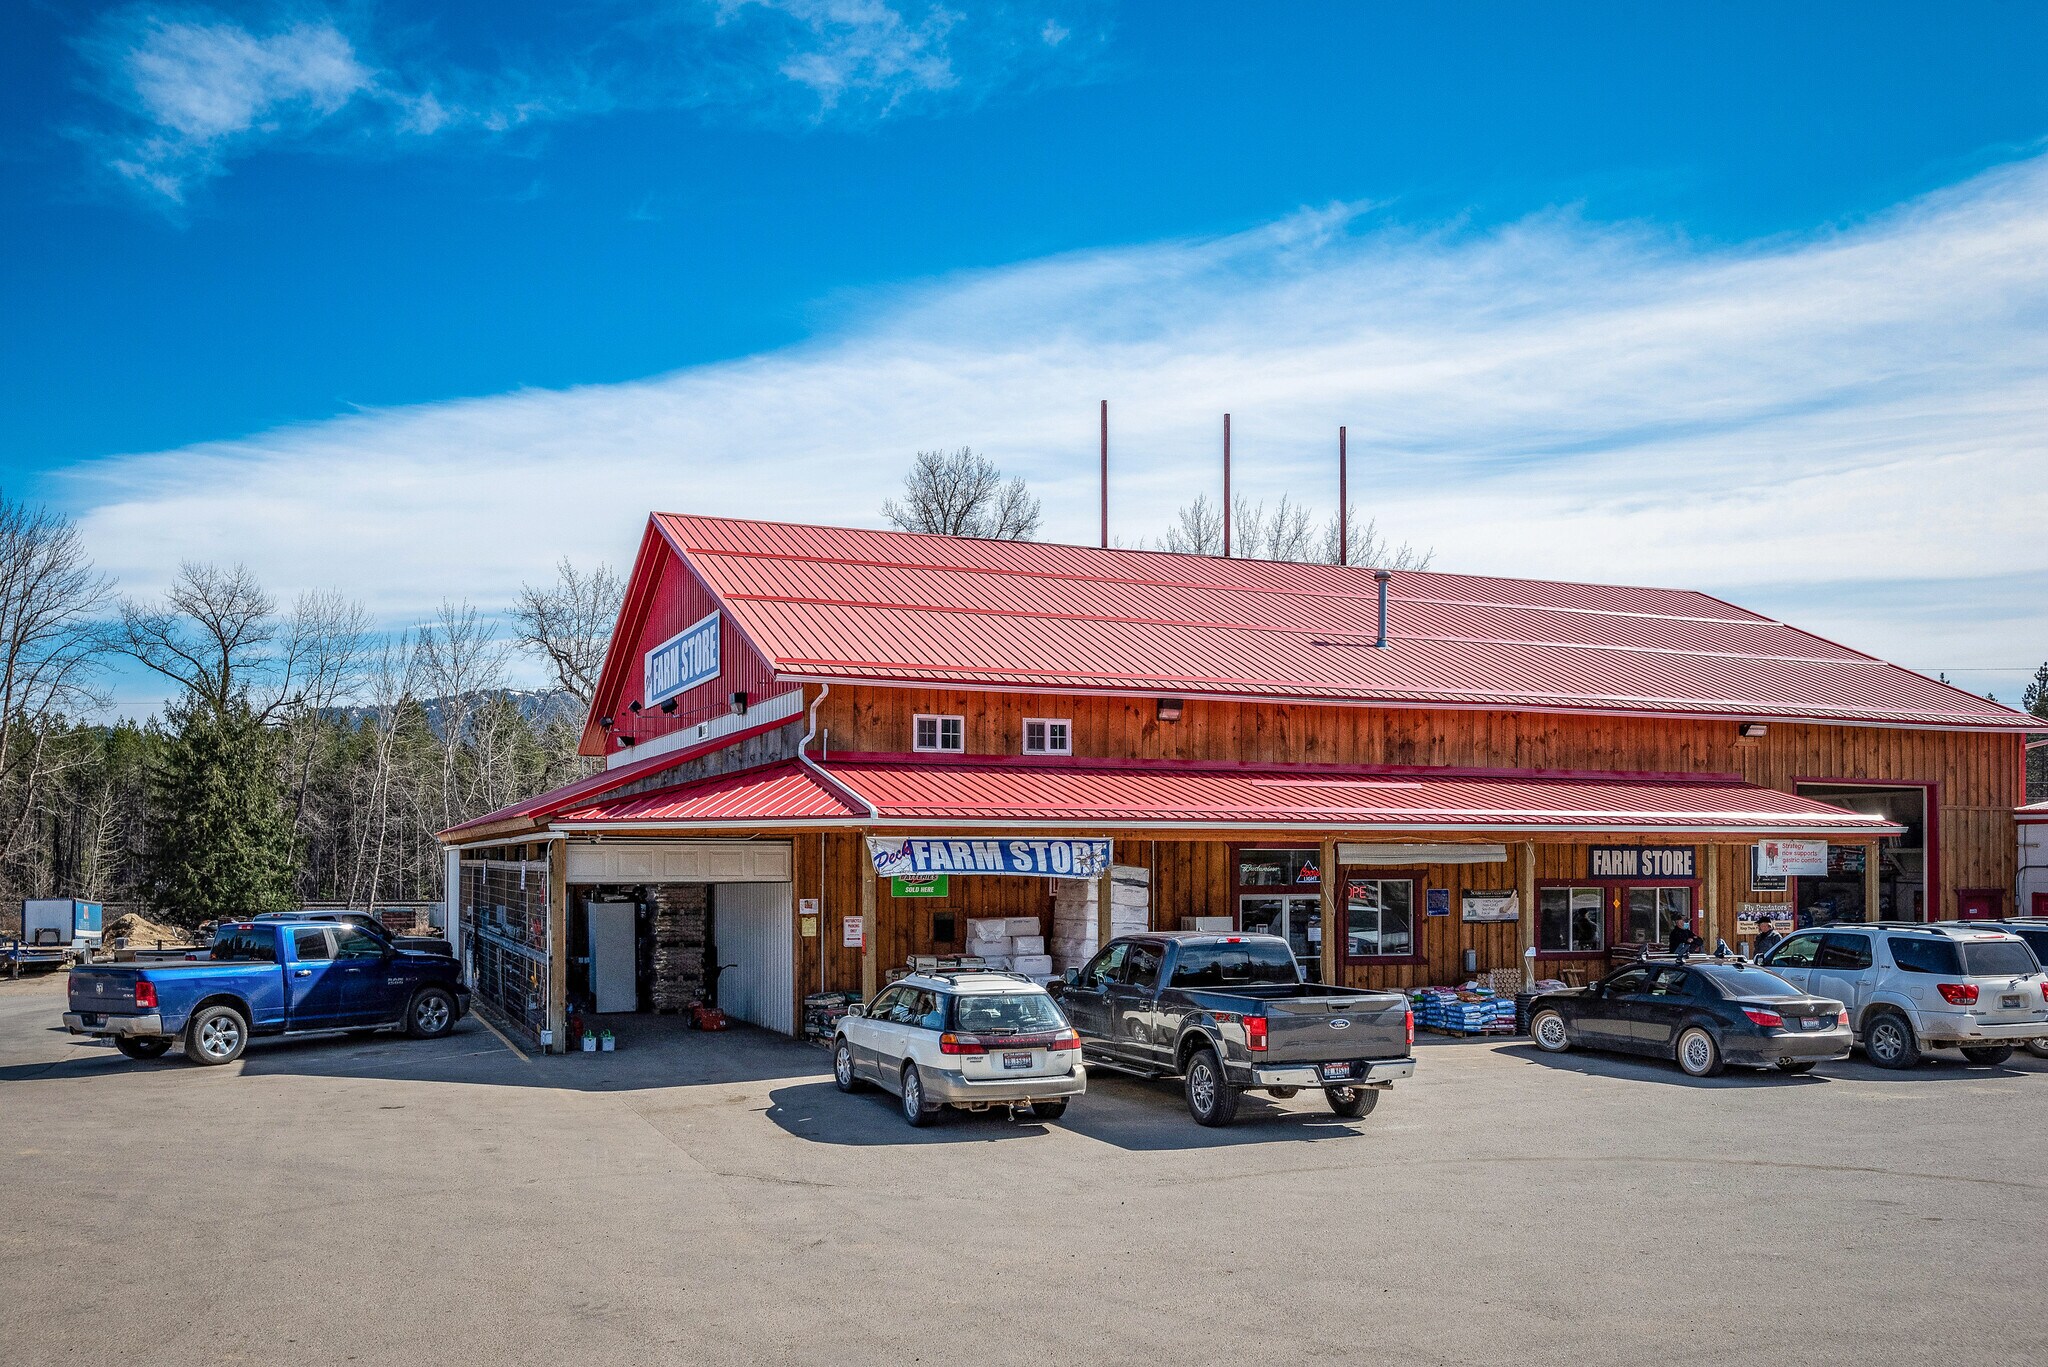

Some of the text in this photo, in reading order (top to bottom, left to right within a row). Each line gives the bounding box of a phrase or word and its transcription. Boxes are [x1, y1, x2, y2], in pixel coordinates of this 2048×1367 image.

[653, 624, 716, 696] FARM STORE
[911, 841, 1005, 870] FARM
[1009, 841, 1107, 874] STORE
[1593, 850, 1693, 876] FARM STORE
[1240, 864, 1280, 873] Budweiser
[1300, 867, 1321, 877] Coors
[1744, 904, 1755, 912] Fly
